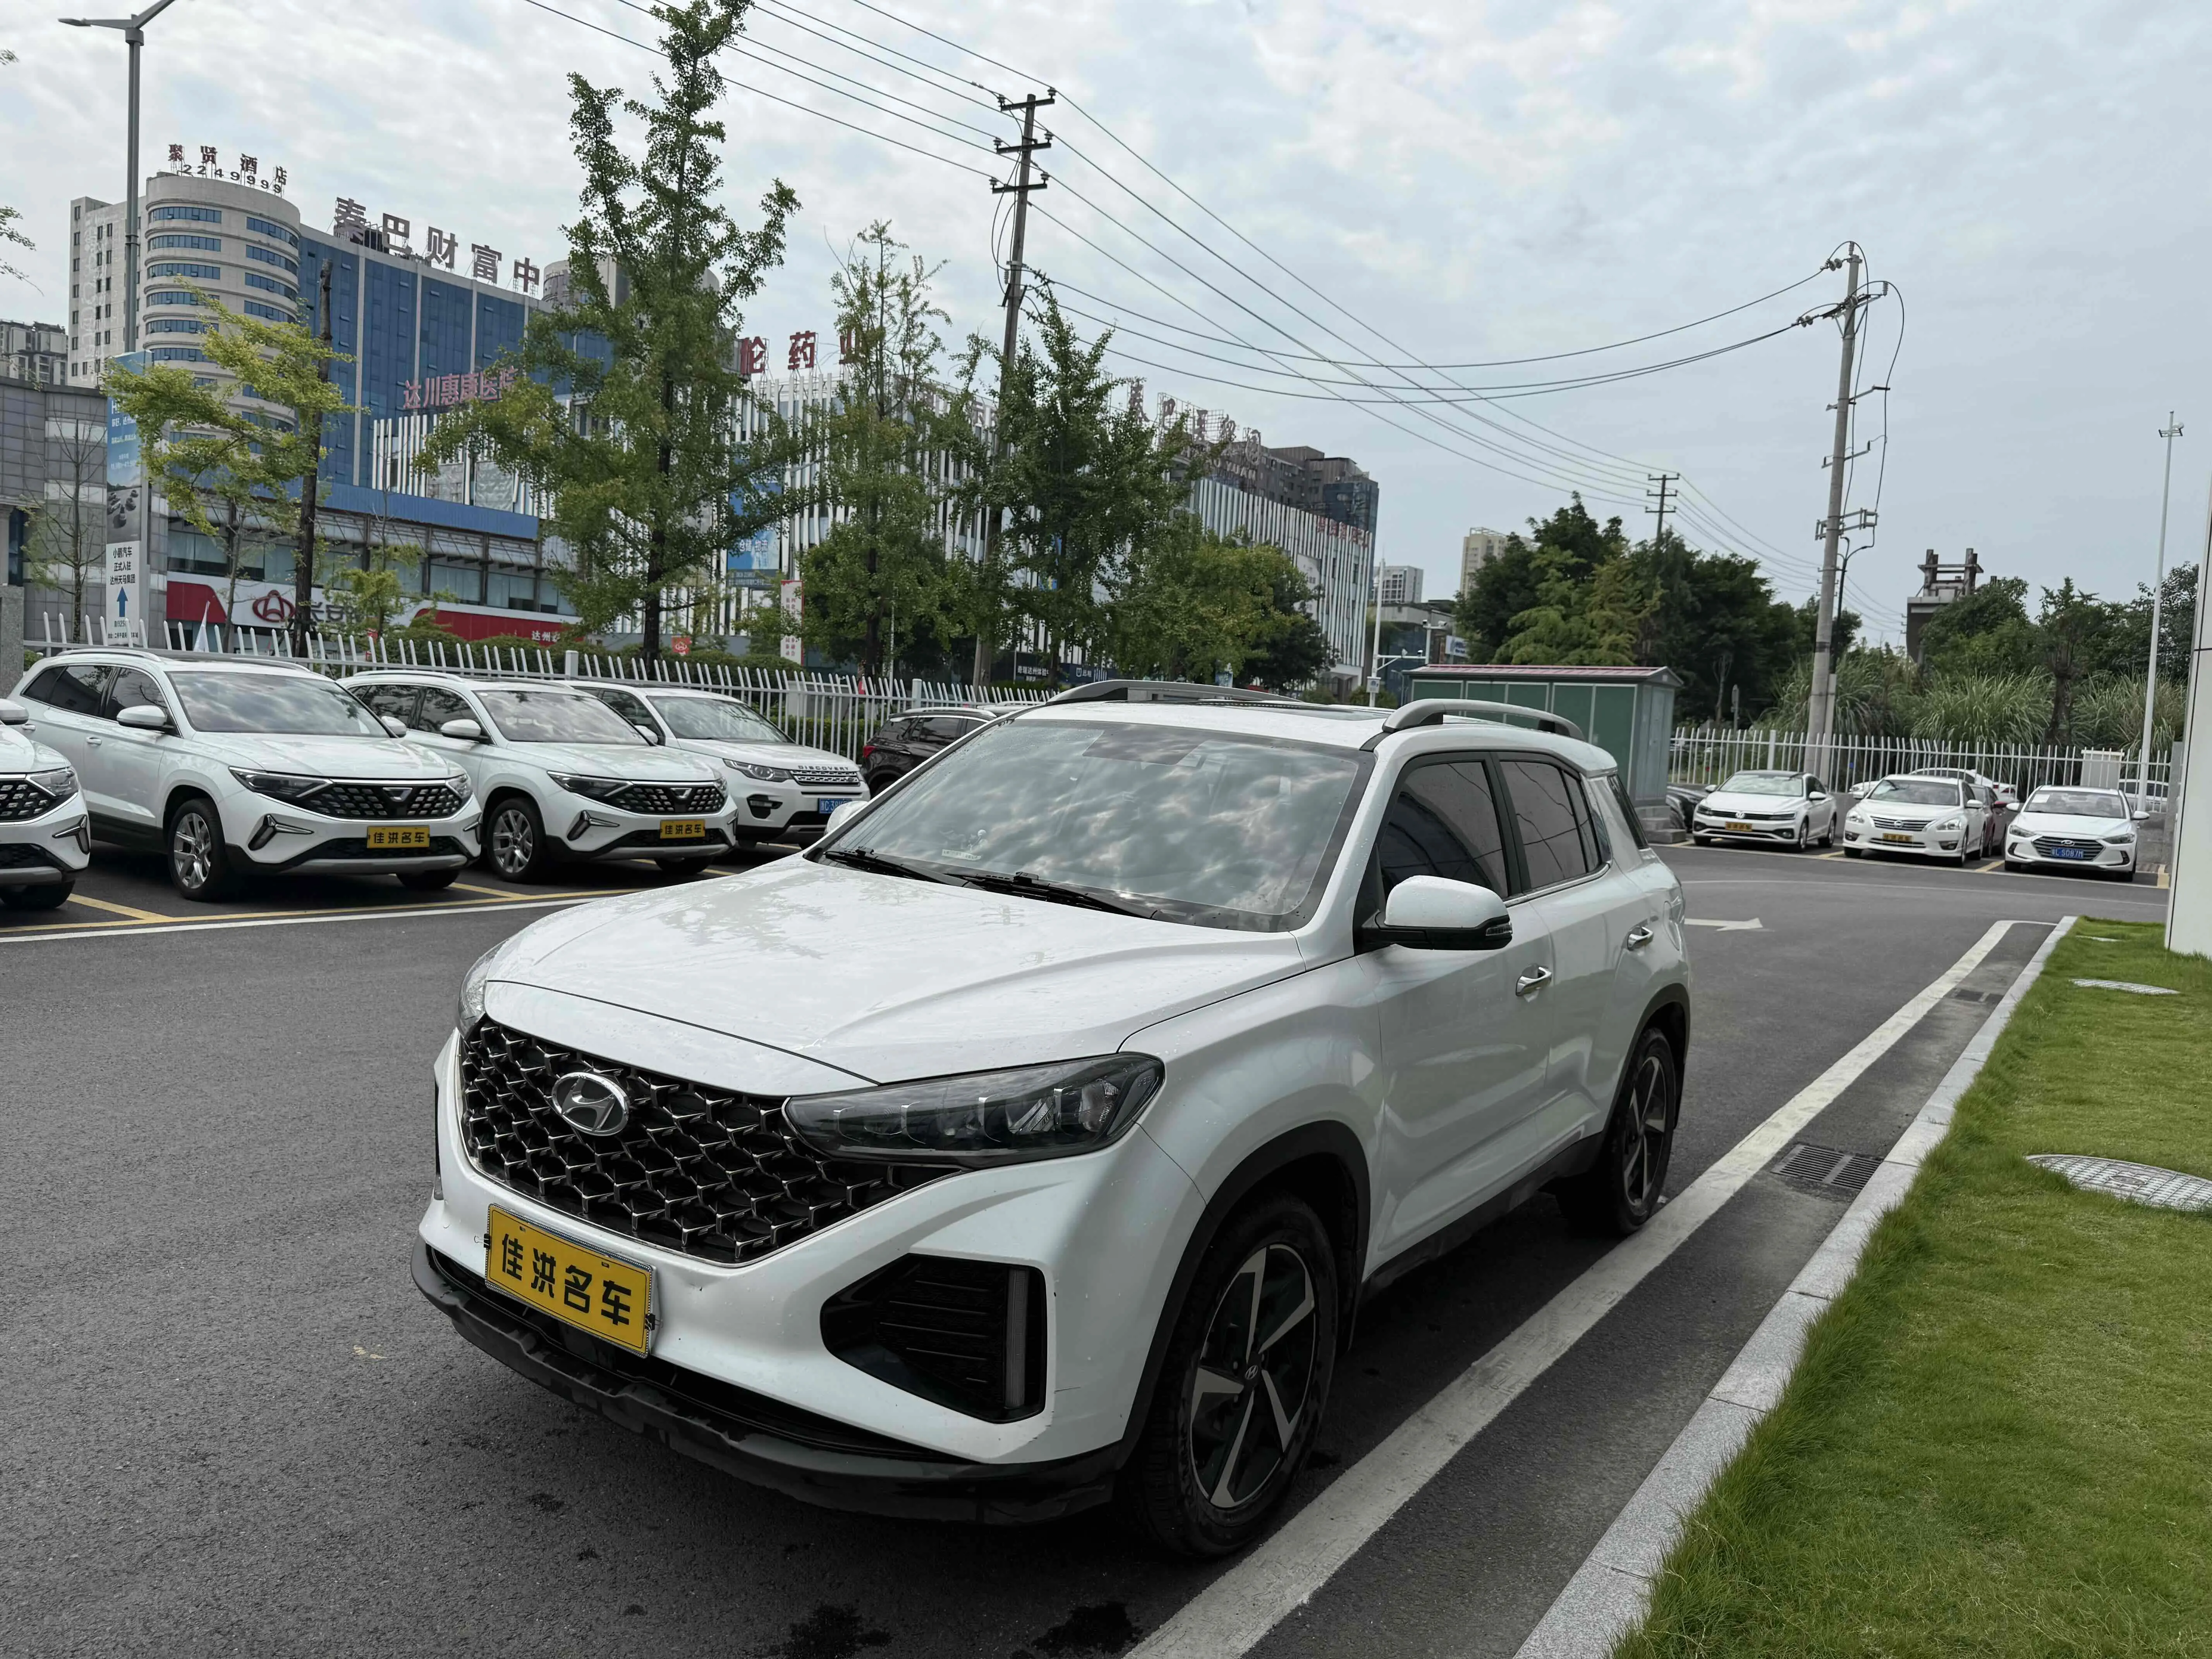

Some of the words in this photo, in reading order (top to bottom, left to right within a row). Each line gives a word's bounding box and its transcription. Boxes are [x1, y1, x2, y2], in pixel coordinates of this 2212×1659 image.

[168, 144, 287, 185] 聚贤酒店
[183, 164, 282, 194] 2249999
[113, 546, 132, 558] 小鹏汽车
[114, 562, 131, 571] 正式入驻
[665, 824, 701, 835] 佳洪名车
[374, 832, 424, 843] 佳洪名车
[502, 1233, 632, 1326] 佳洪名车
